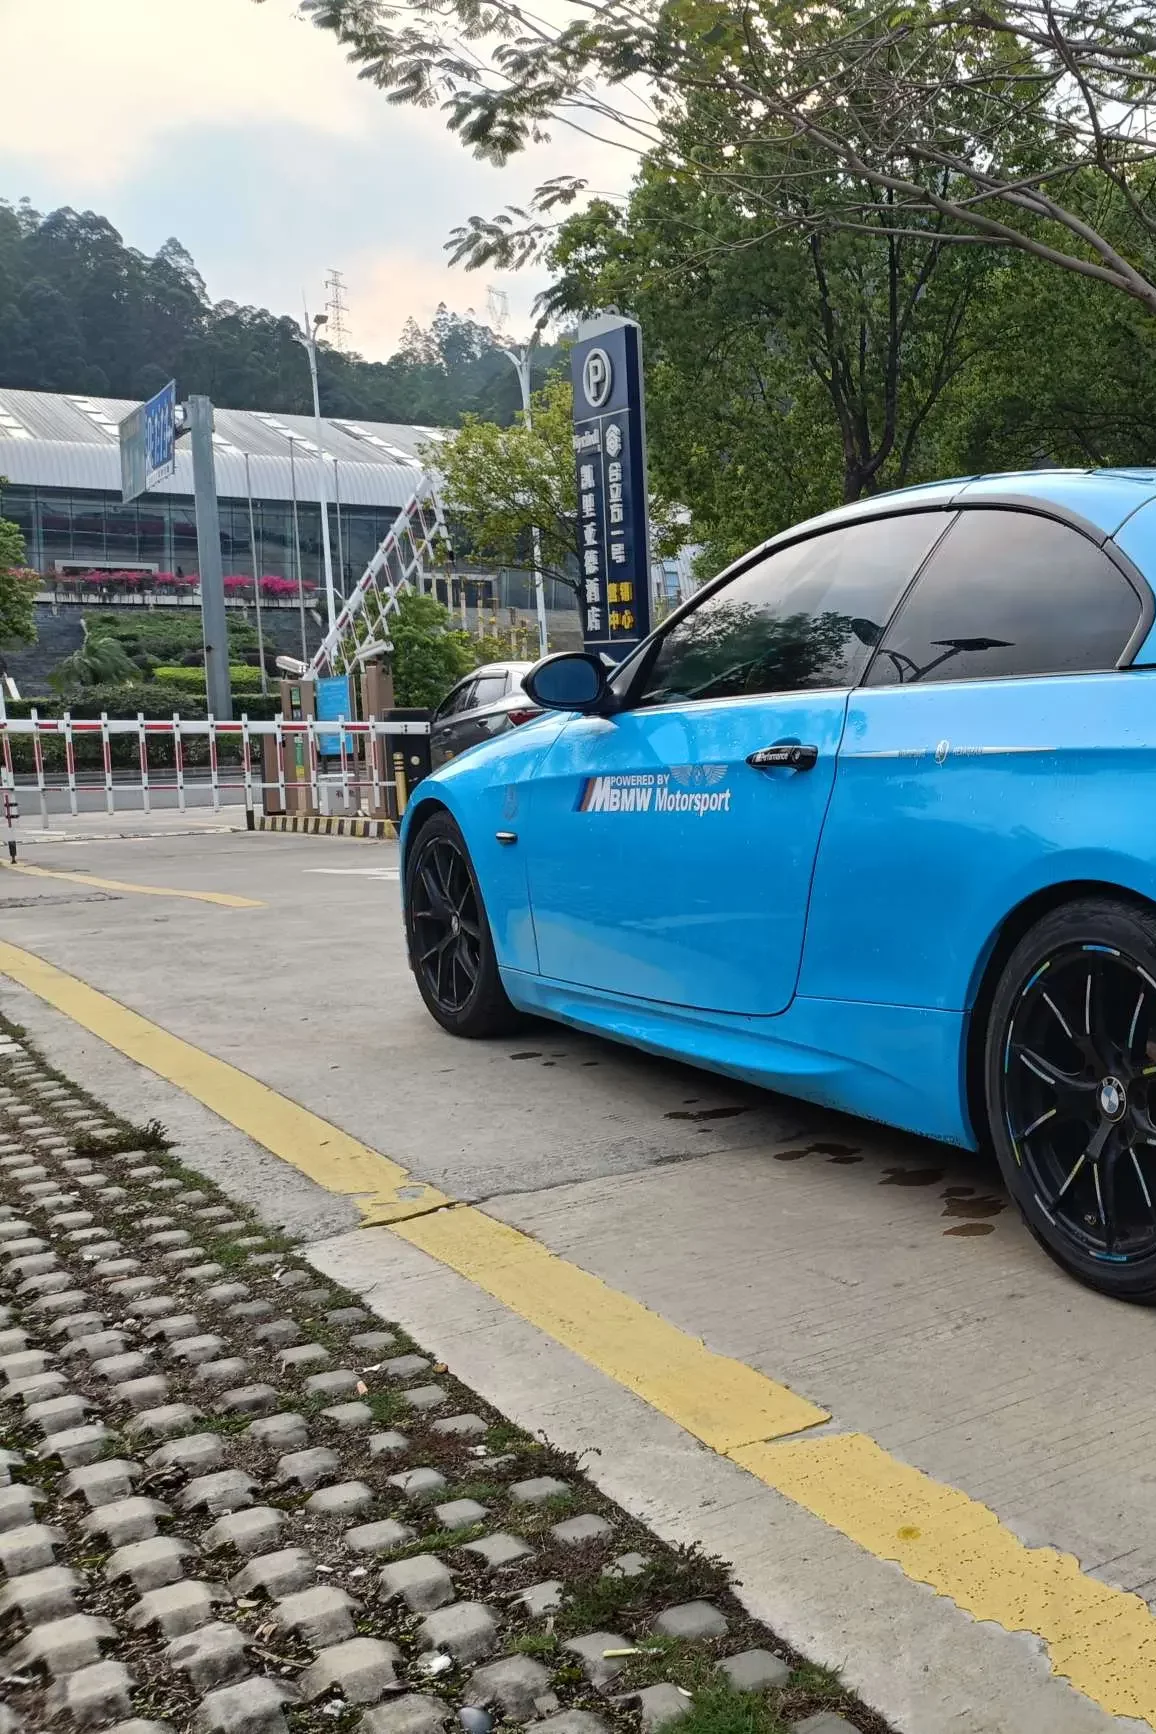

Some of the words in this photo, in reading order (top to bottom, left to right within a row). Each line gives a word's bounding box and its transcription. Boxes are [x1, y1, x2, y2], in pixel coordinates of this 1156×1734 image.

[589, 358, 606, 398] P
[611, 775, 654, 787] POWERED
[657, 774, 670, 785] BY
[609, 788, 652, 812] BMW
[654, 787, 731, 817] Motorsport
